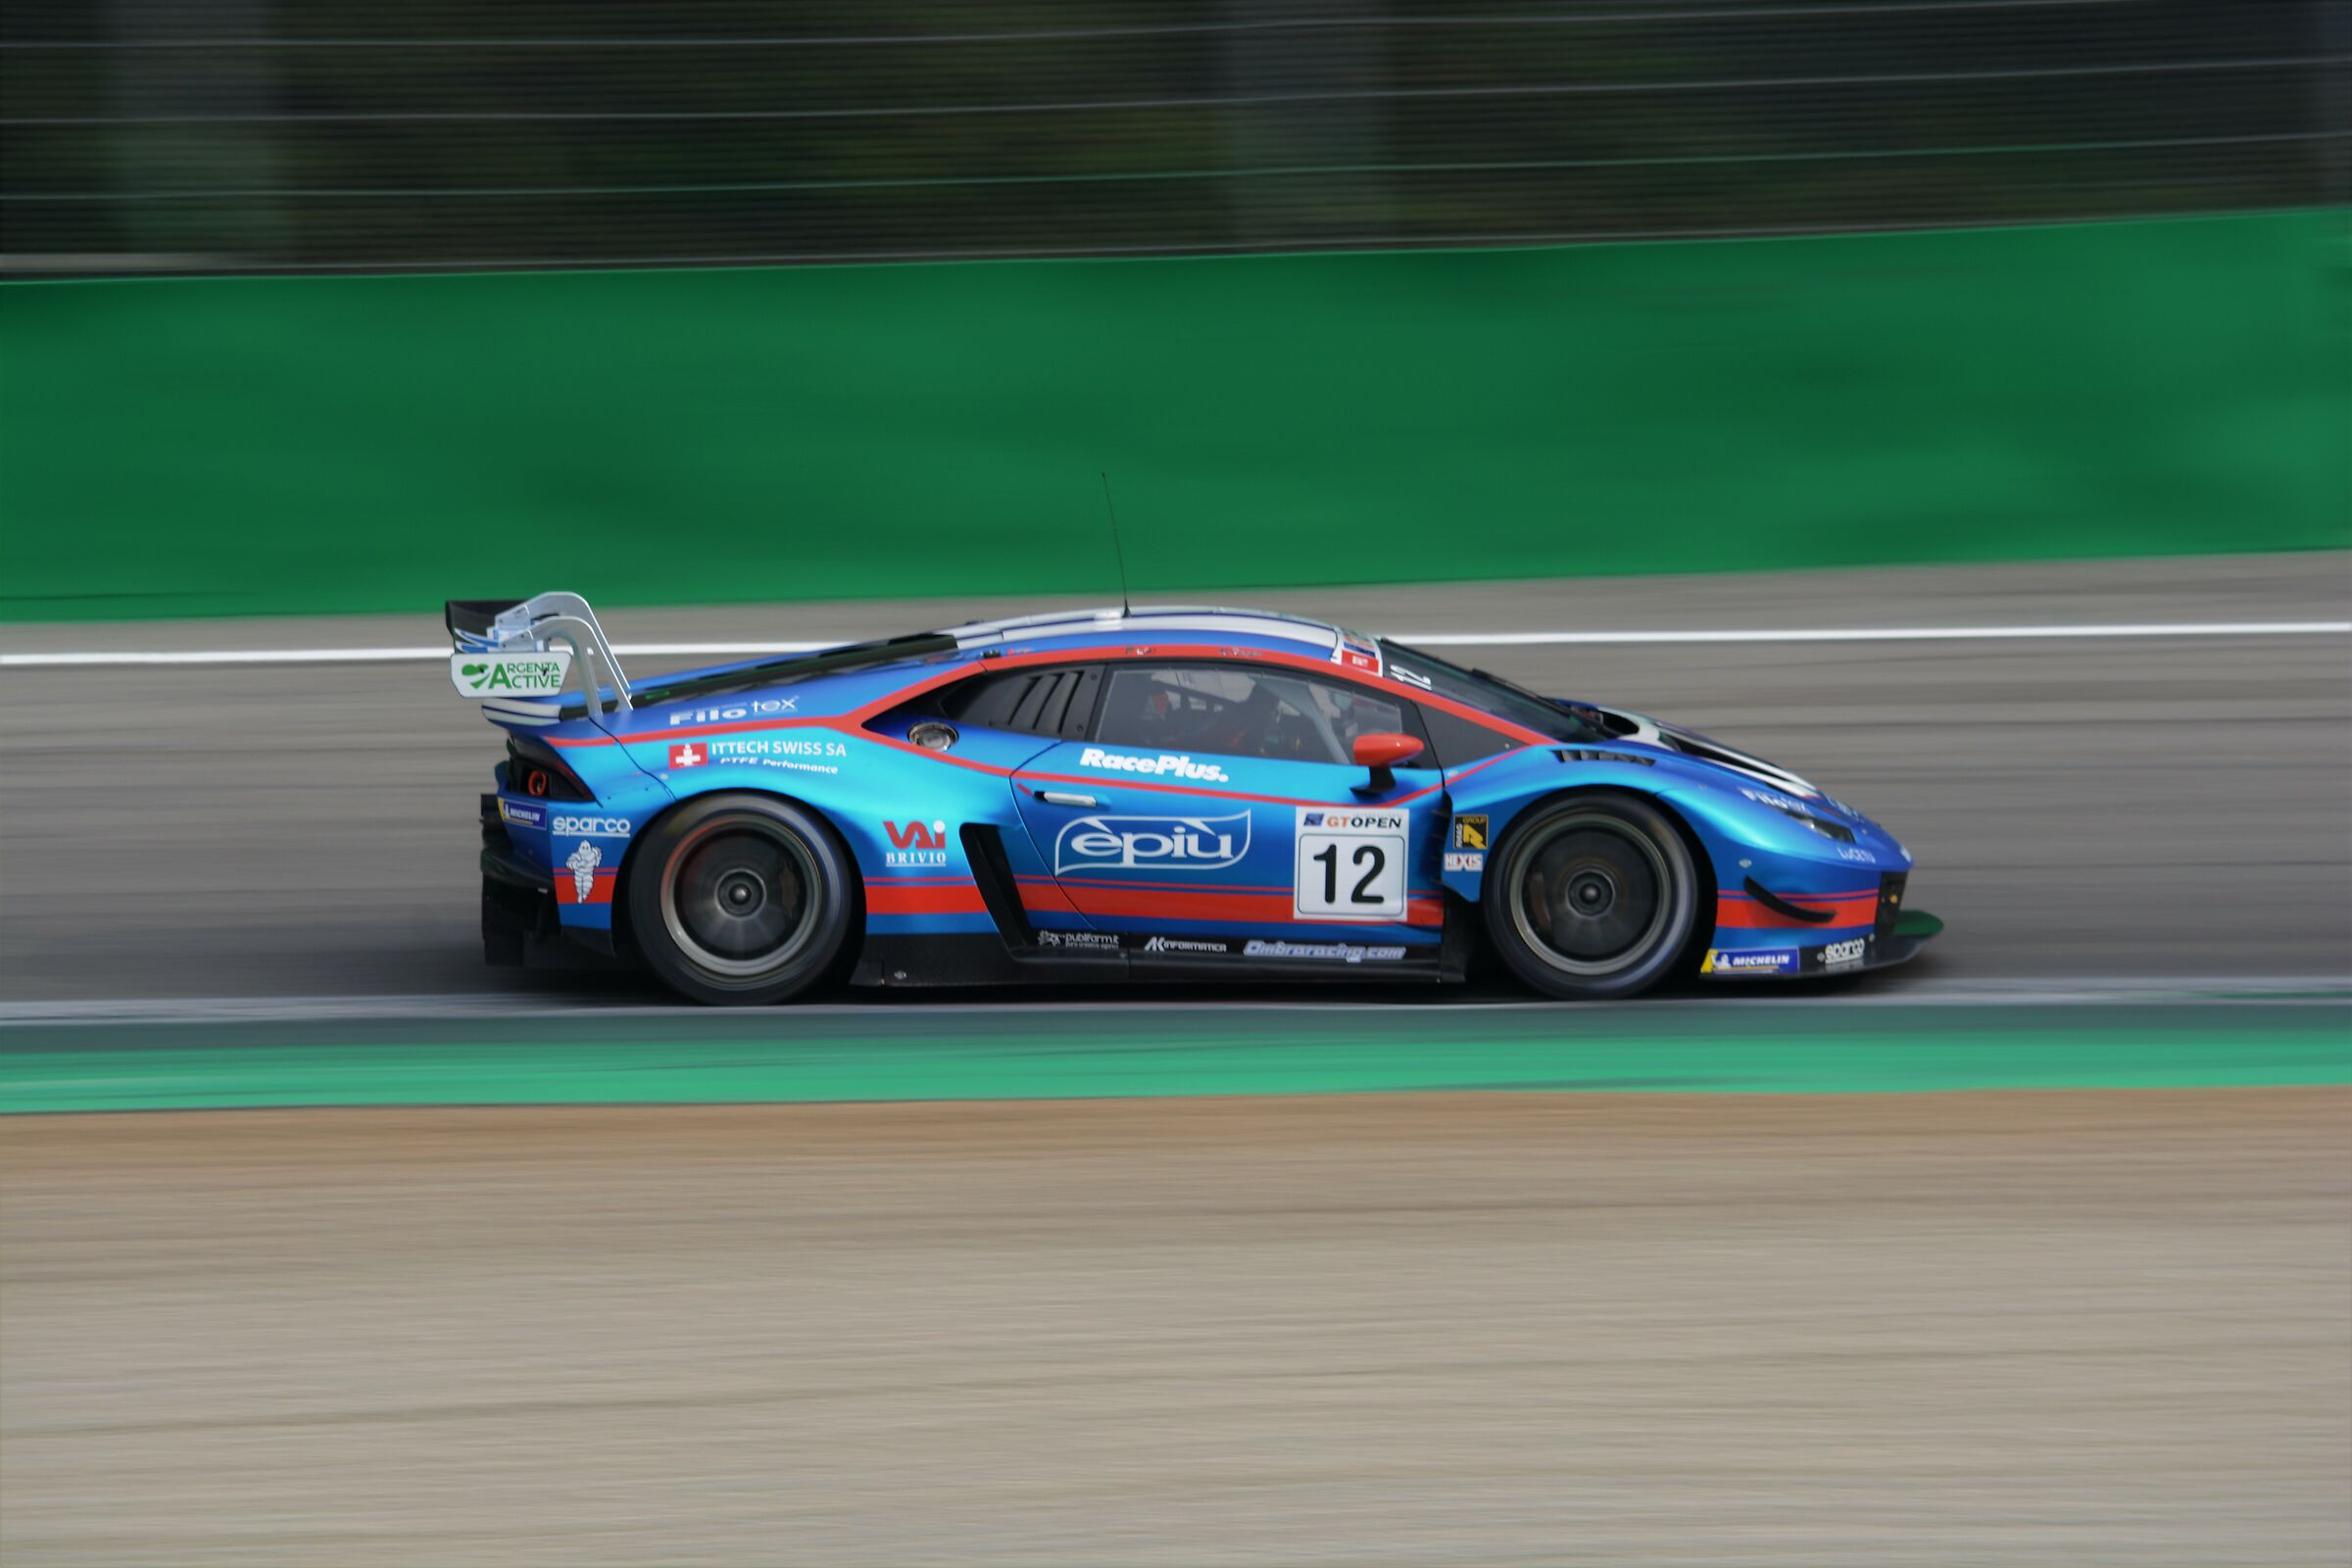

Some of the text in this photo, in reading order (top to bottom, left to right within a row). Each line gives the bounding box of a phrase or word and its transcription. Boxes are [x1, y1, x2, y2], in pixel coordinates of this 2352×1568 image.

[711, 741, 847, 758] ITTECH SWISS SA
[762, 758, 839, 774] Performance
[552, 816, 631, 837] sparco
[886, 852, 947, 863] BRIVIO
[1312, 843, 1386, 905] 12
[1825, 938, 1866, 964] sparco
[1732, 955, 1789, 965] MICHELIN
